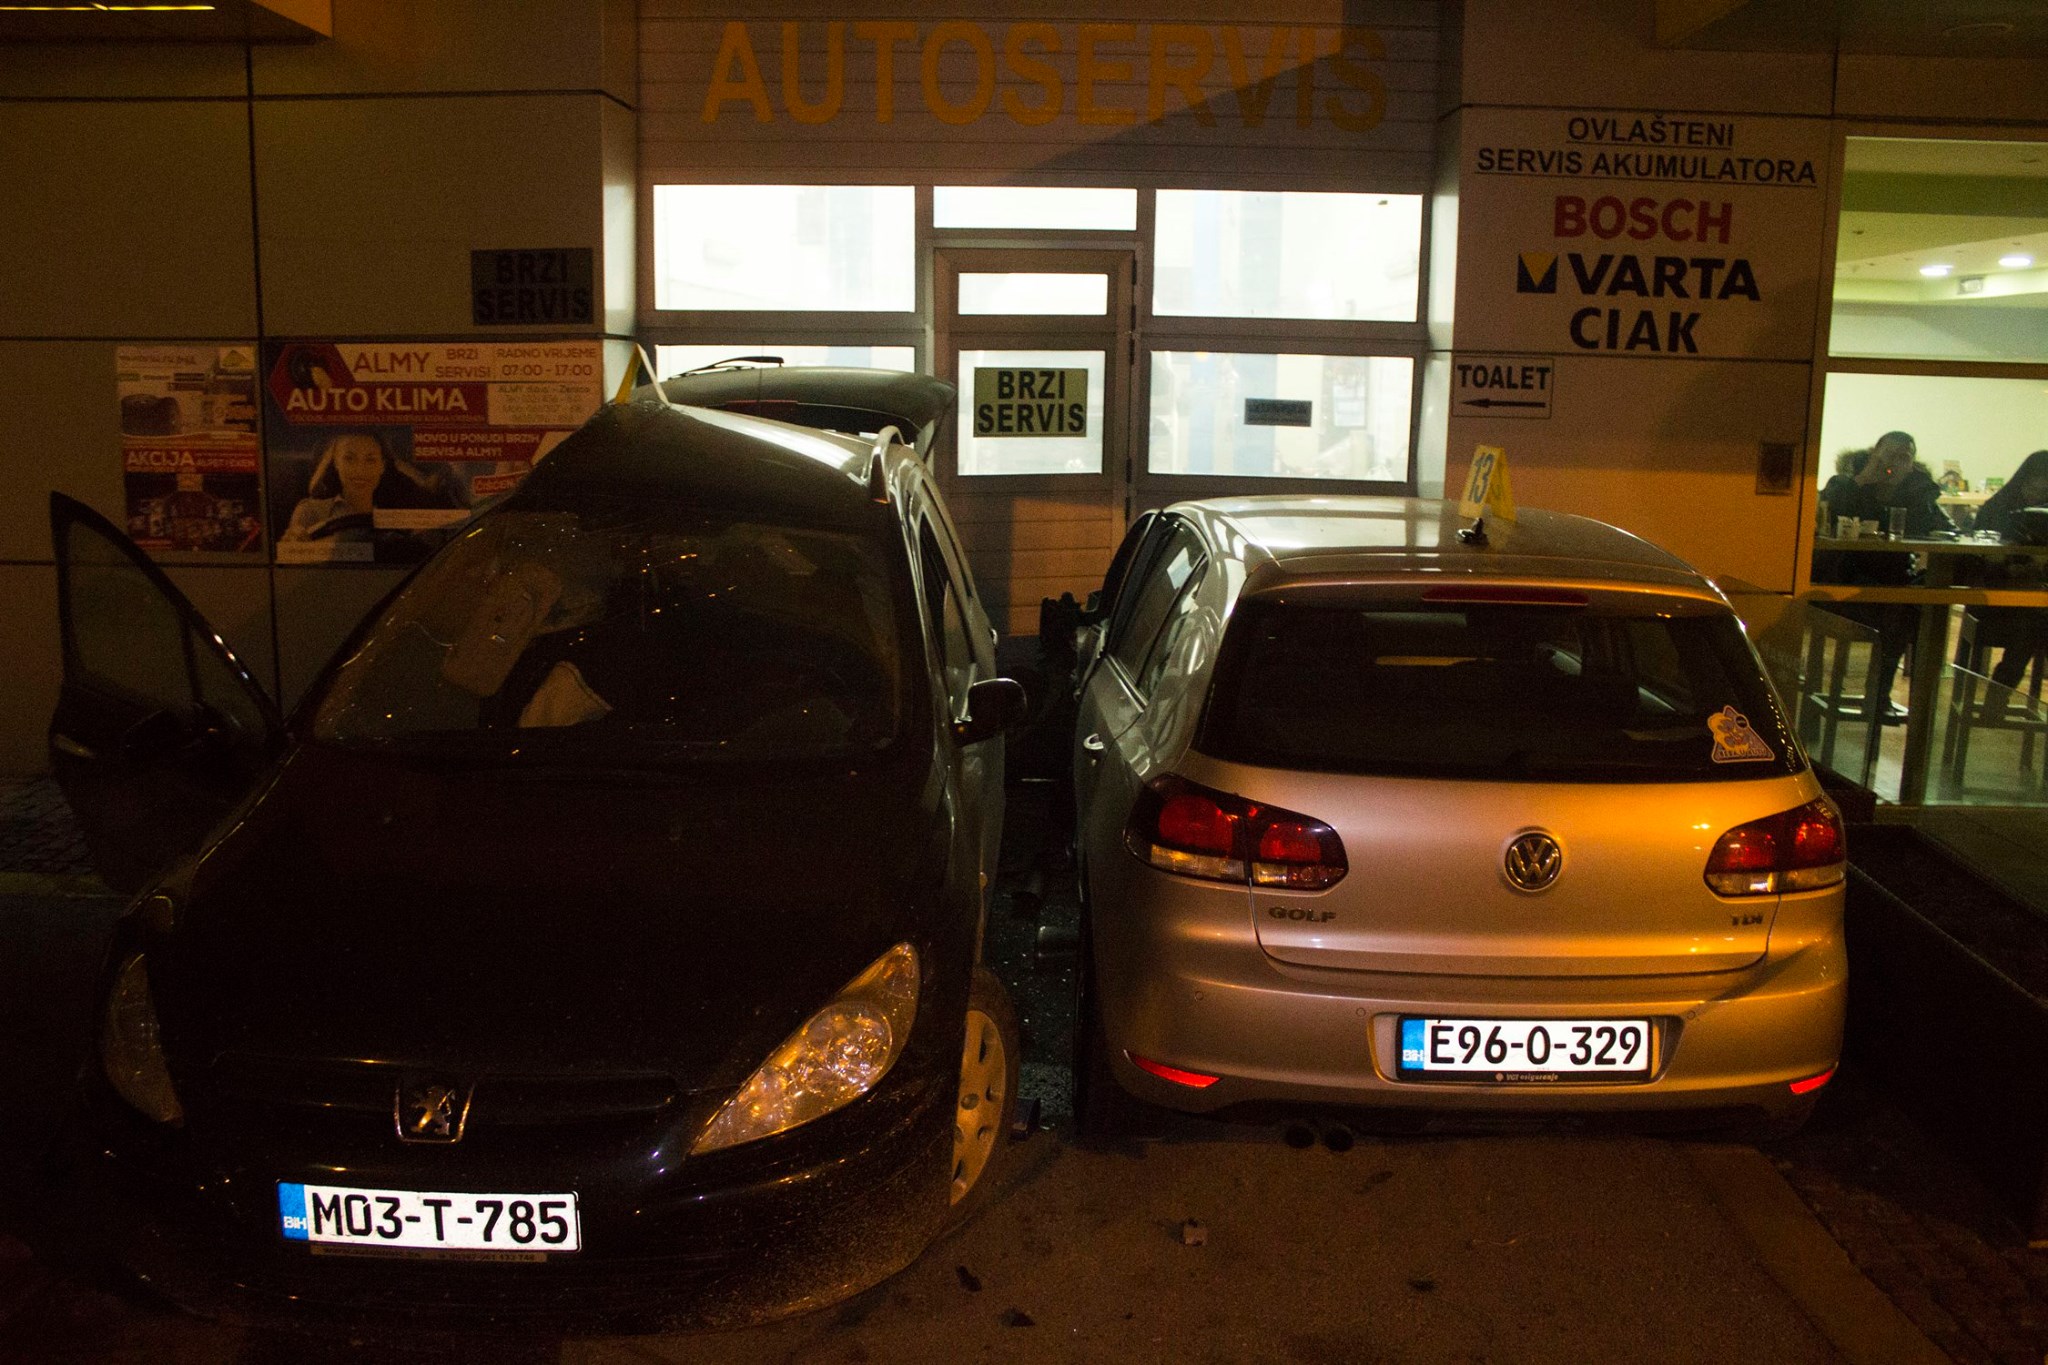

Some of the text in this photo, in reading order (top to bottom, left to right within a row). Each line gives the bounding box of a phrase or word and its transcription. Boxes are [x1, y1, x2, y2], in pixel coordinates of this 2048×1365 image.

[702, 19, 1388, 133] AUTOSERVIS
[1567, 112, 1734, 147] OVLAŠTENI
[1477, 147, 1817, 184] SERVIS AKUMULATORA
[1554, 195, 1733, 244] BOSCH
[496, 252, 569, 284] BRZI
[1567, 253, 1761, 301] VARTA
[476, 288, 590, 320] SERVIS
[1569, 306, 1702, 354] CIAK
[352, 351, 430, 373] ALMY
[446, 348, 479, 360] BRZI
[496, 347, 598, 359] RADNO VRIJEME
[435, 365, 491, 378] SERVISI
[501, 364, 543, 376] 07:00
[555, 364, 593, 376] 17:00
[1457, 363, 1551, 391] TOALET
[286, 387, 468, 411] AUTO KLIMA
[997, 370, 1066, 400] BRZI
[977, 402, 1085, 433] SERVIS
[414, 433, 449, 443] NOVO
[451, 433, 459, 443] U
[414, 446, 465, 457] SERVISA
[127, 450, 195, 466] AKCIJA
[1467, 451, 1495, 504] 13
[1267, 905, 1337, 923] GOLF
[283, 1215, 307, 1230] BIH
